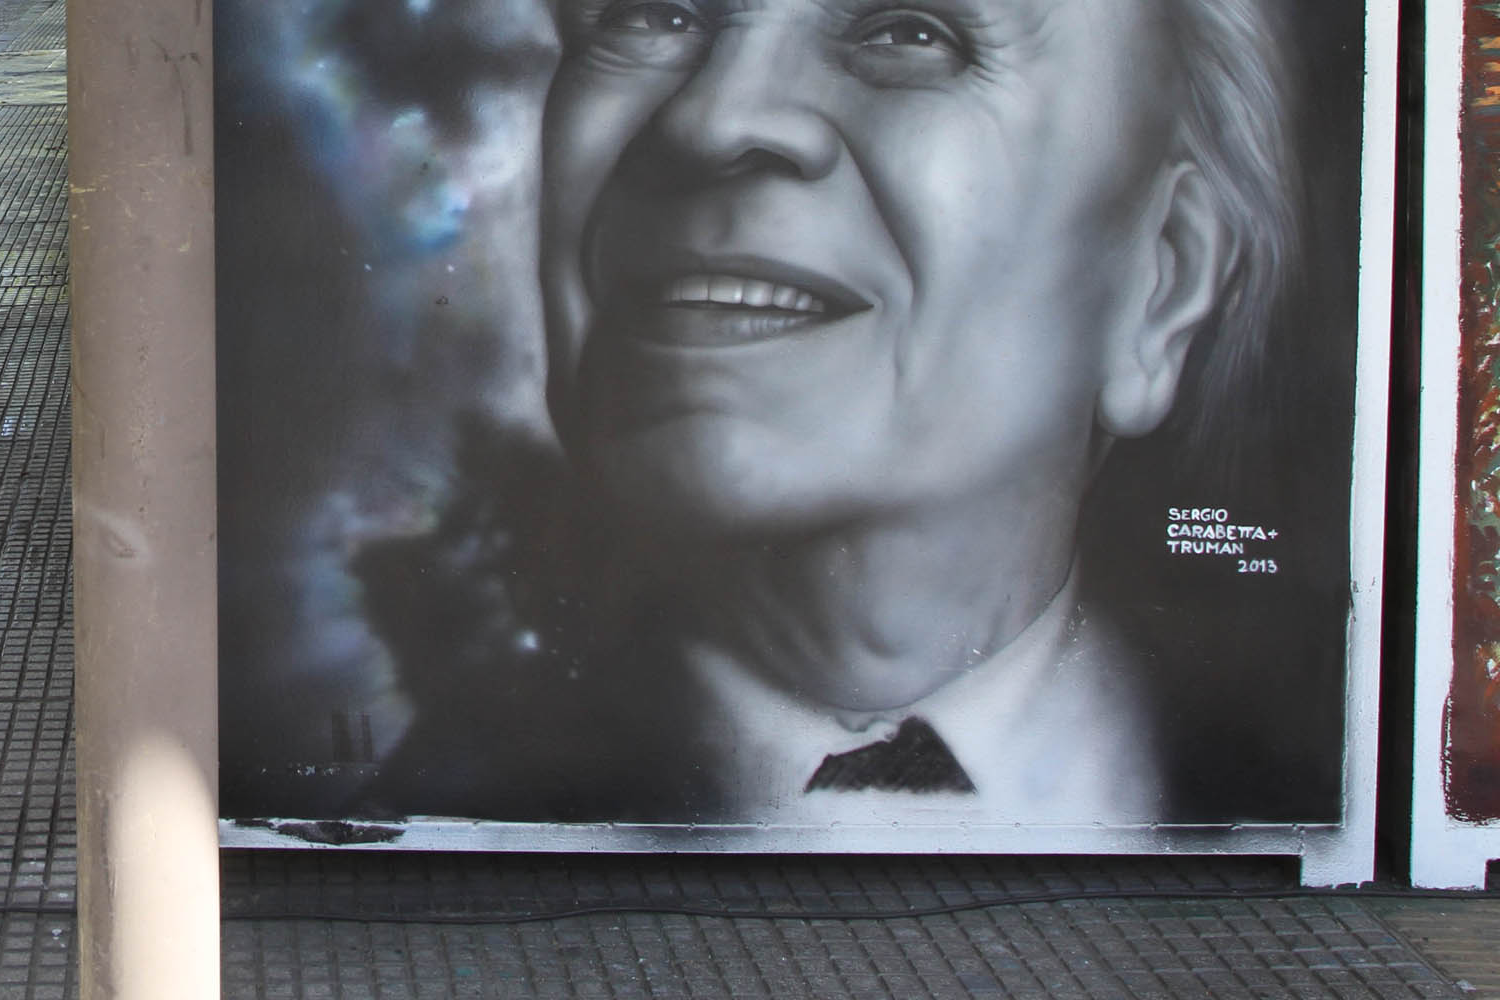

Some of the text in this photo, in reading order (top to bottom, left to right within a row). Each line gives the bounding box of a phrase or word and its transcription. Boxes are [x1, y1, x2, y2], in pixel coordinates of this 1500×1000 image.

[1168, 507, 1229, 523] SERGIO
[1166, 540, 1244, 555] TRUMAN
[1237, 559, 1278, 574] 2013
